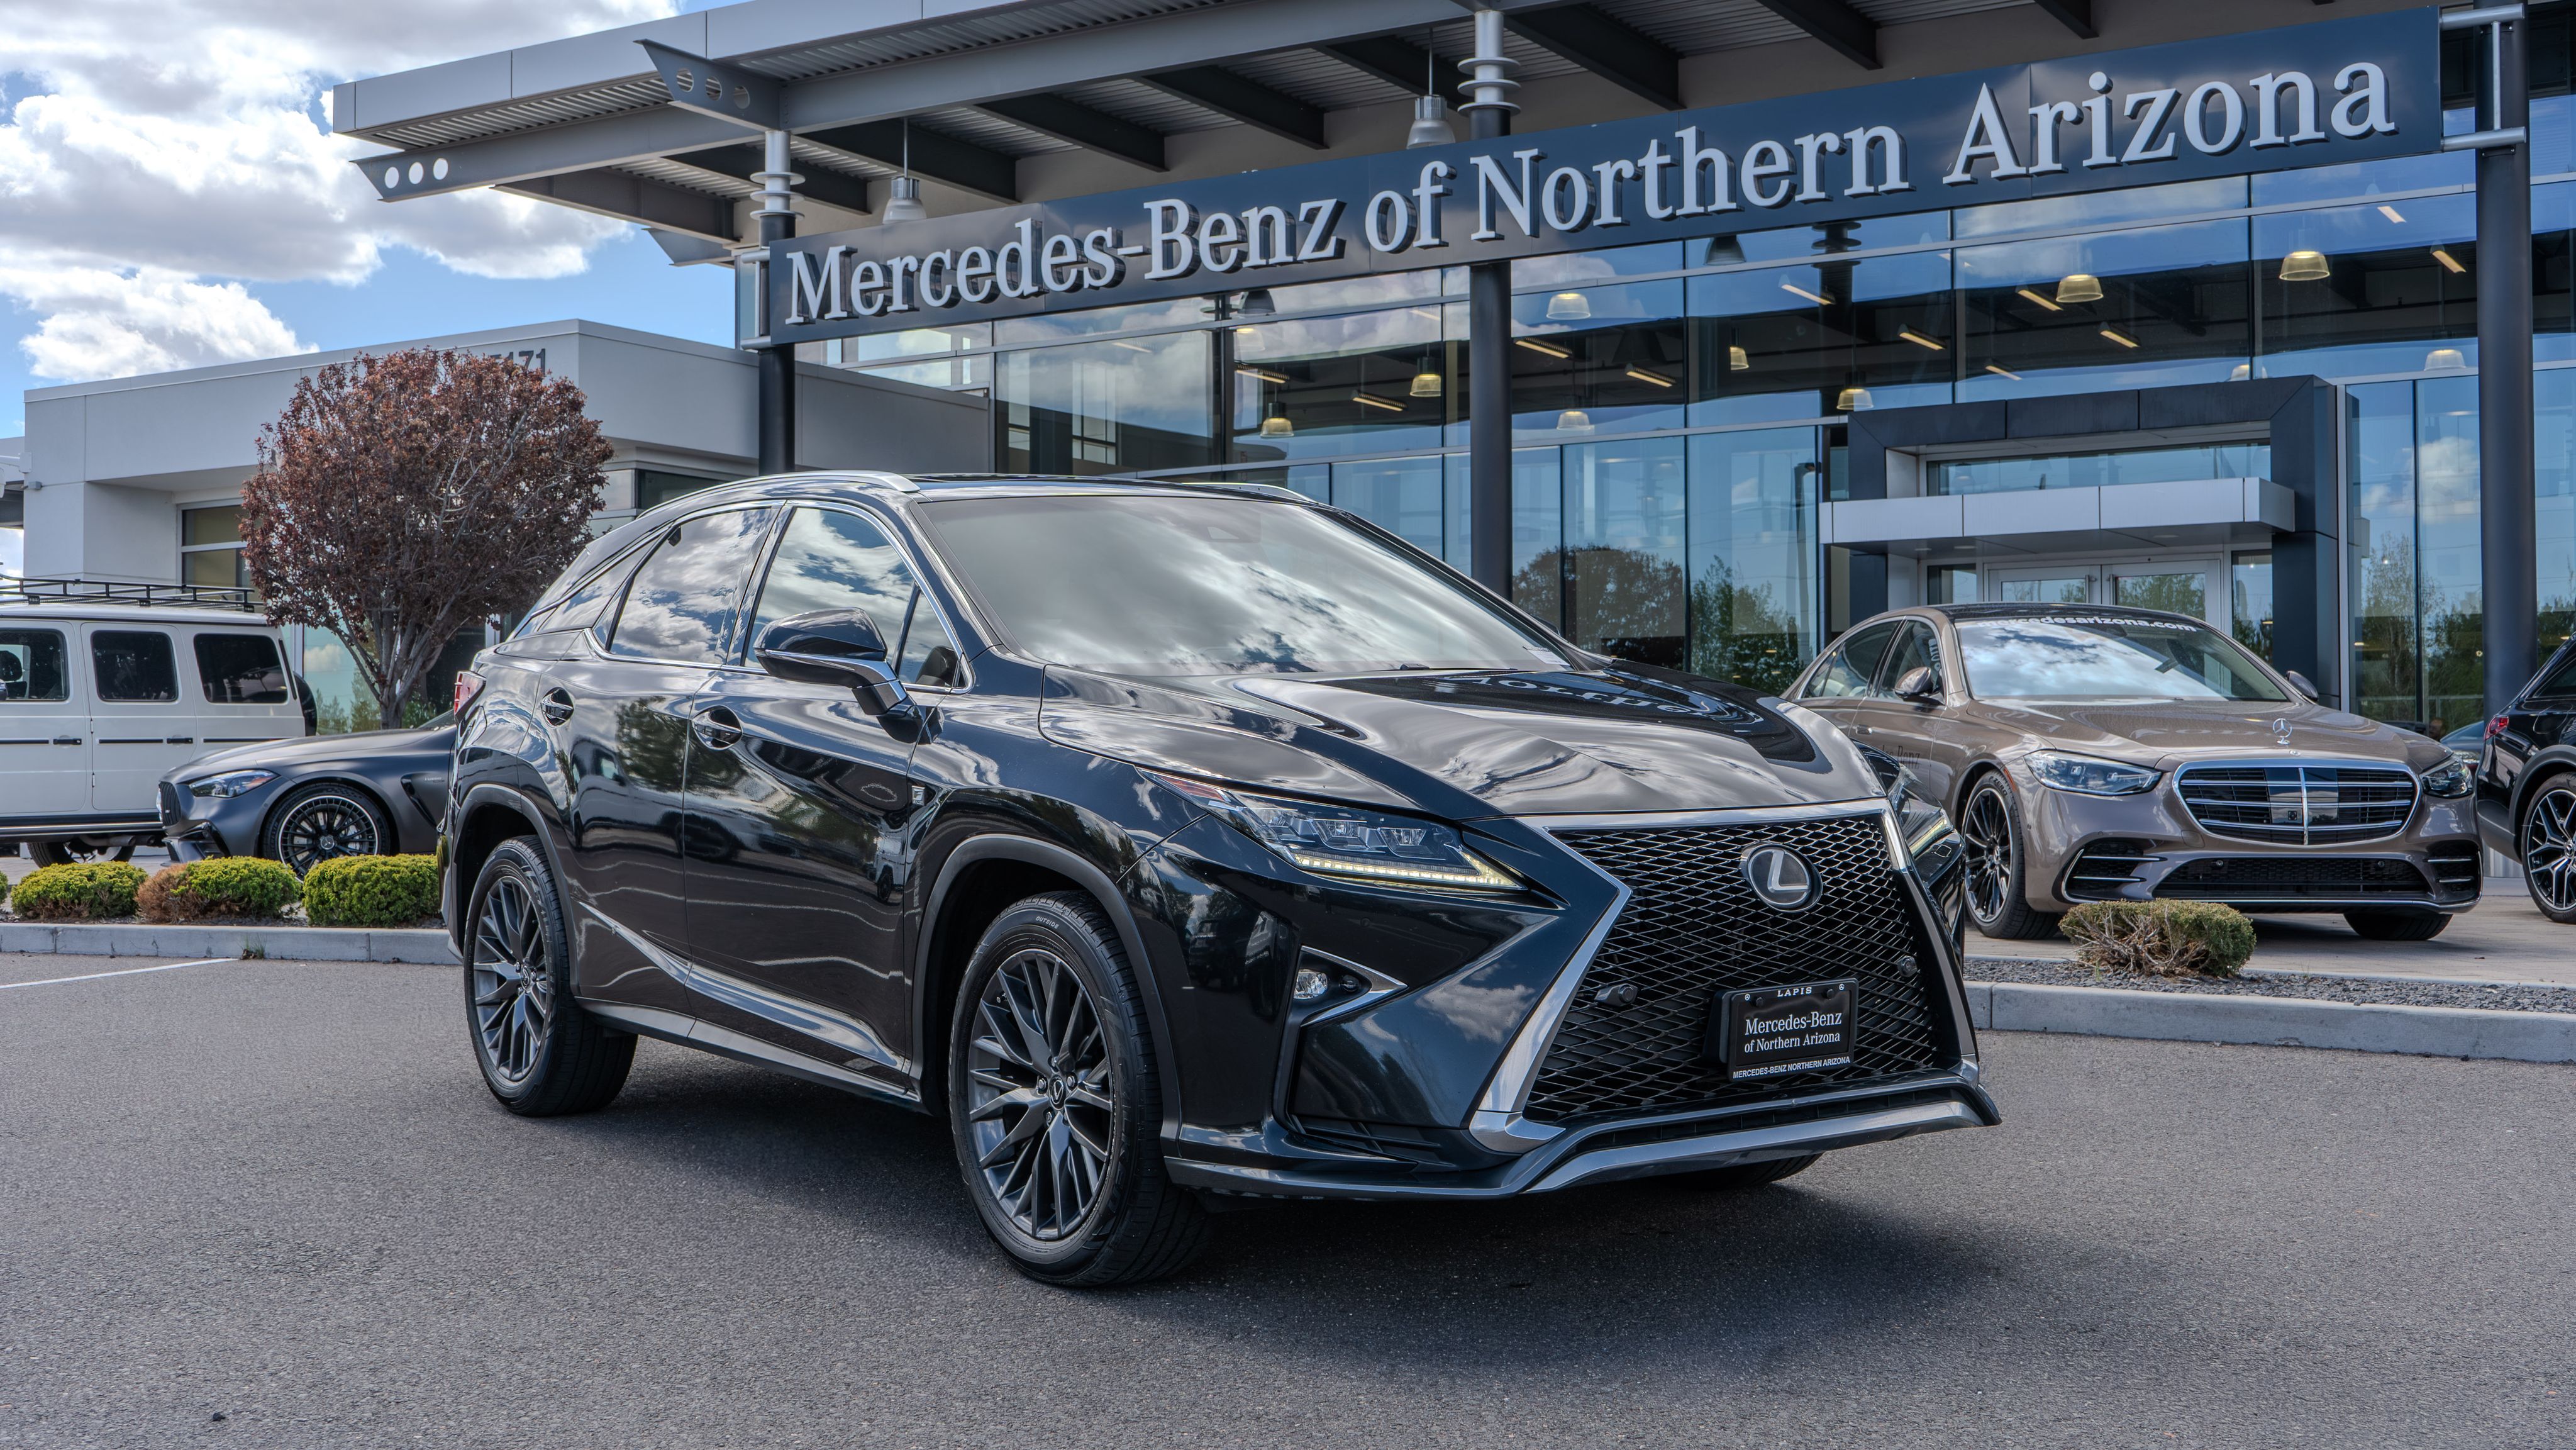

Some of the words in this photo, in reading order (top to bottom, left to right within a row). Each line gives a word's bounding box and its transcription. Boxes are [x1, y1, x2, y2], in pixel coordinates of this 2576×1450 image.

[785, 197, 1342, 325] Mercedes-Benz
[1365, 162, 1450, 253] of
[1469, 126, 1910, 242] Northern
[1942, 63, 2397, 184] Arizona
[1977, 616, 2197, 632] mercedesarizona.com
[1036, 916, 1060, 929] OUTSIDE
[1777, 986, 1812, 997] LAPIS
[1745, 1012, 1842, 1035] Mercedes-Benz
[1745, 1039, 1755, 1053] of
[1756, 1036, 1801, 1052] Northern
[1802, 1032, 1841, 1046] Arizona
[1733, 1064, 1787, 1079] MERCEDES-BENZ
[1787, 1060, 1823, 1072] NORTHERN
[1823, 1056, 1851, 1066] ARIZONA
